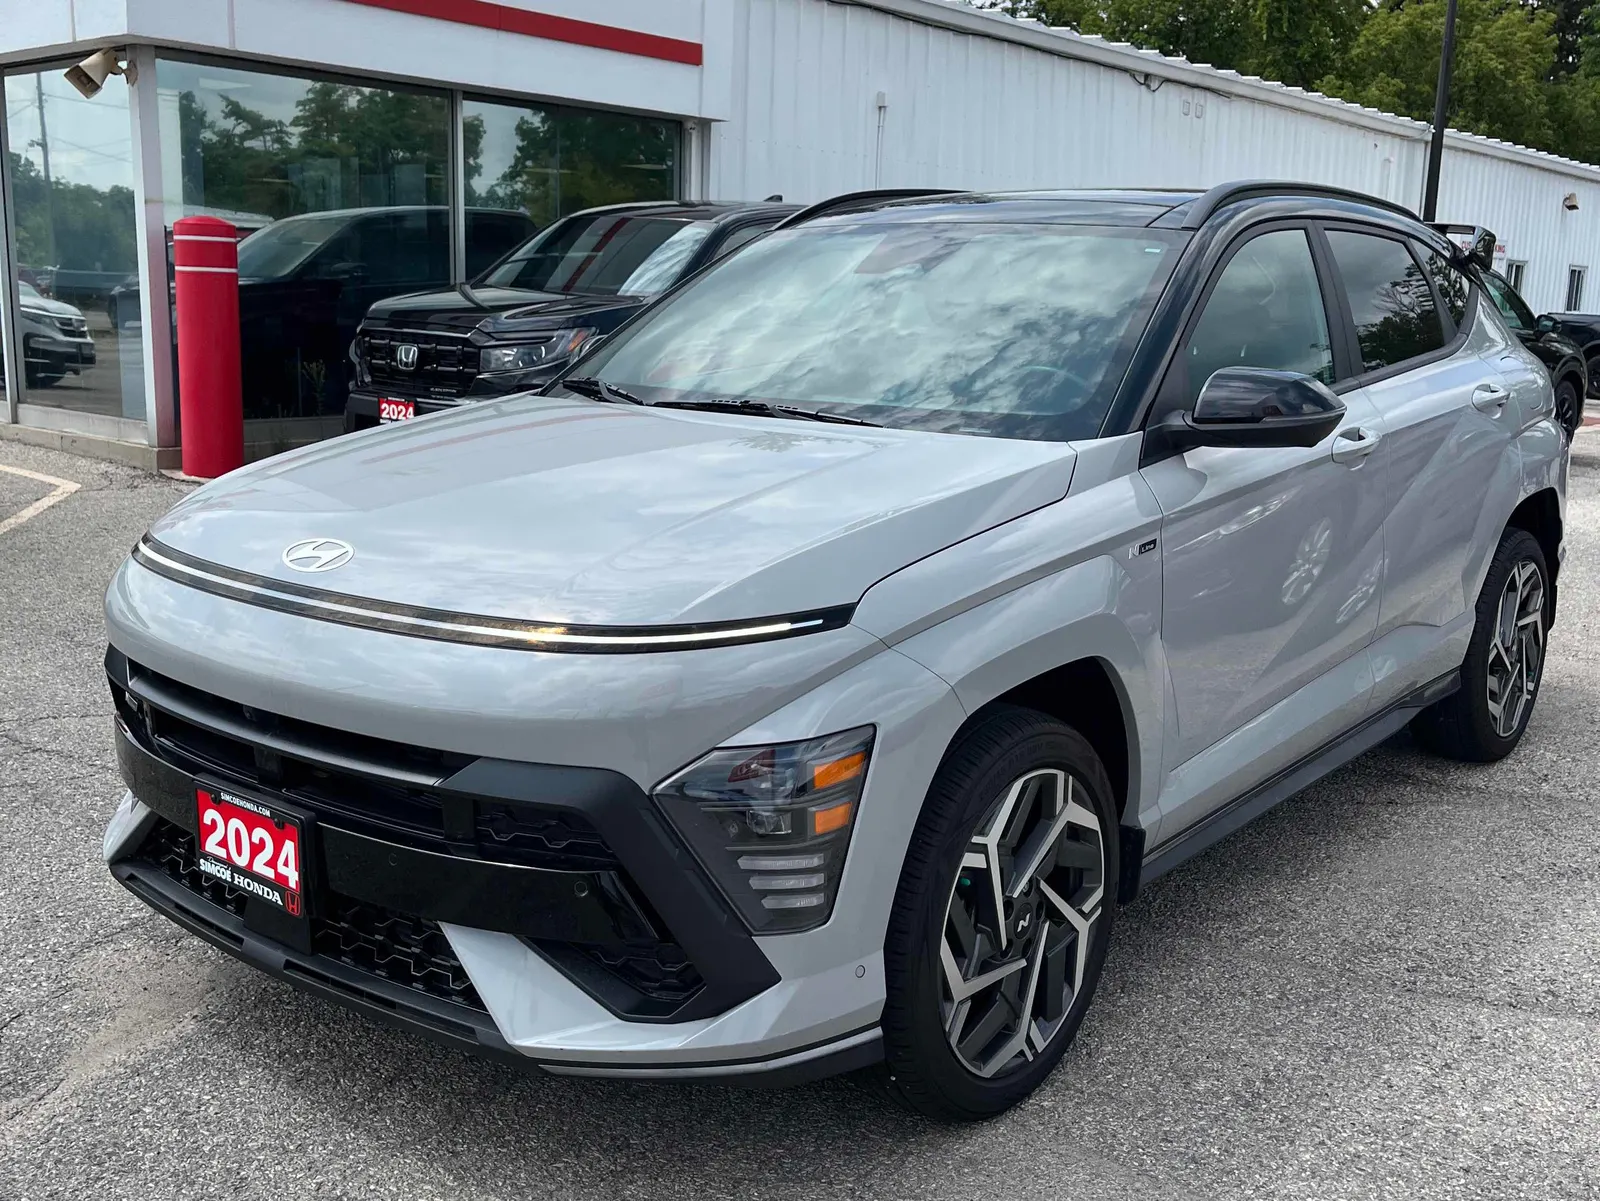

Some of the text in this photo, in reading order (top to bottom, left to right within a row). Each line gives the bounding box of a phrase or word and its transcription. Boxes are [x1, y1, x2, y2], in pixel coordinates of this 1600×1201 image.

[381, 403, 414, 420] 2024
[220, 792, 271, 817] SIMCOEHONDA.COM
[203, 808, 299, 890] 2024
[233, 872, 284, 906] HONDA
